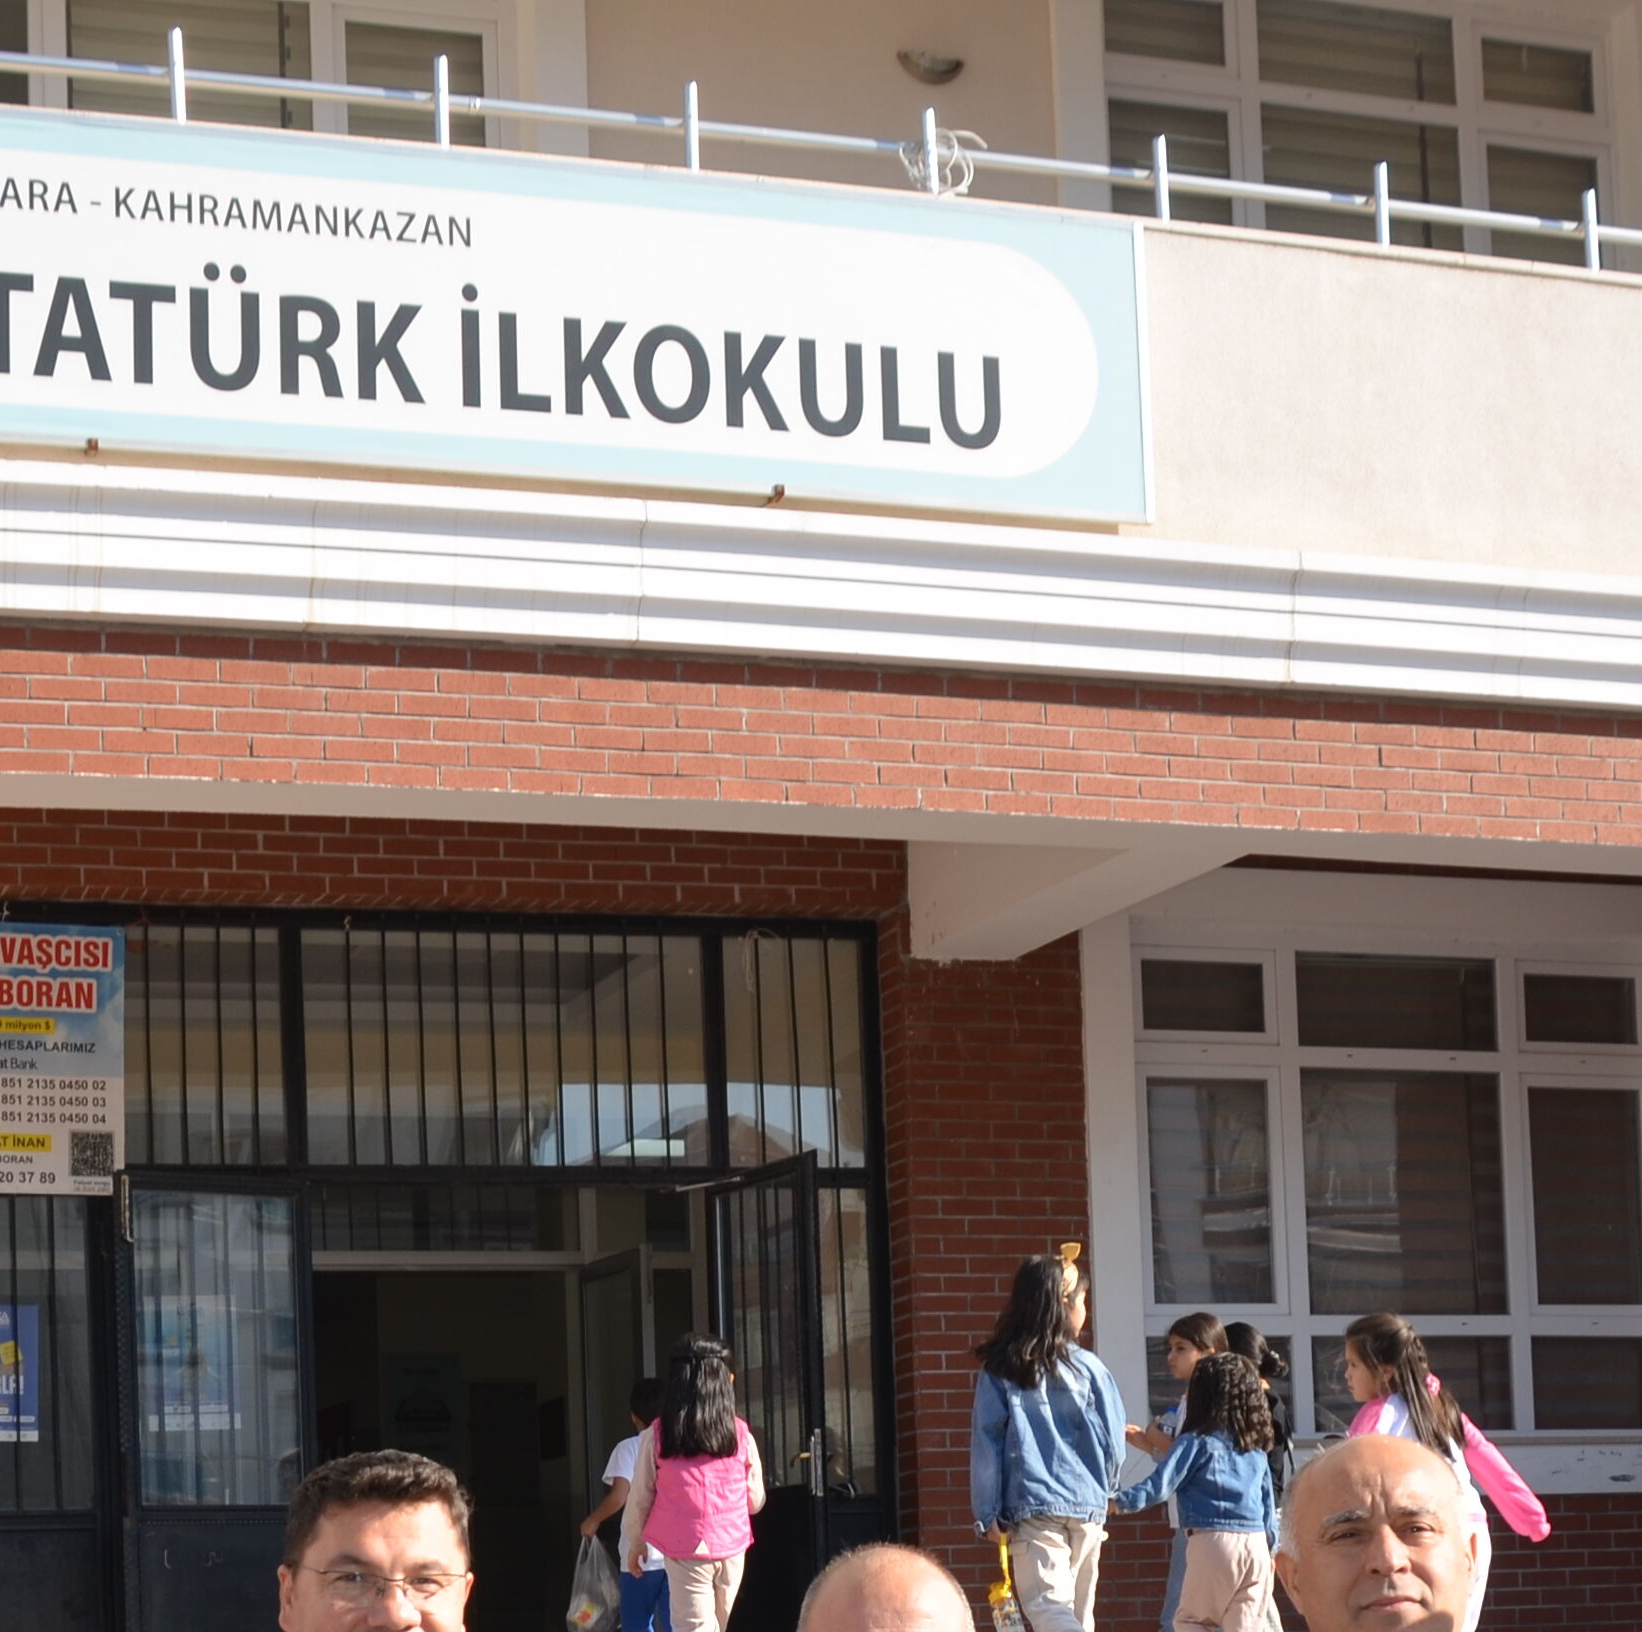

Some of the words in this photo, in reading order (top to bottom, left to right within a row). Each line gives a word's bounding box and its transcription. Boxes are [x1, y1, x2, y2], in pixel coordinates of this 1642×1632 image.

[114, 187, 472, 247] KAHRAMANKAZAN
[459, 283, 1002, 450] İLKOKULU
[5, 1019, 42, 1033] milyon
[9, 1057, 38, 1070] Bank
[12, 1133, 46, 1149] İNAN
[18, 1171, 35, 1184] 37
[39, 1171, 56, 1185] 89
